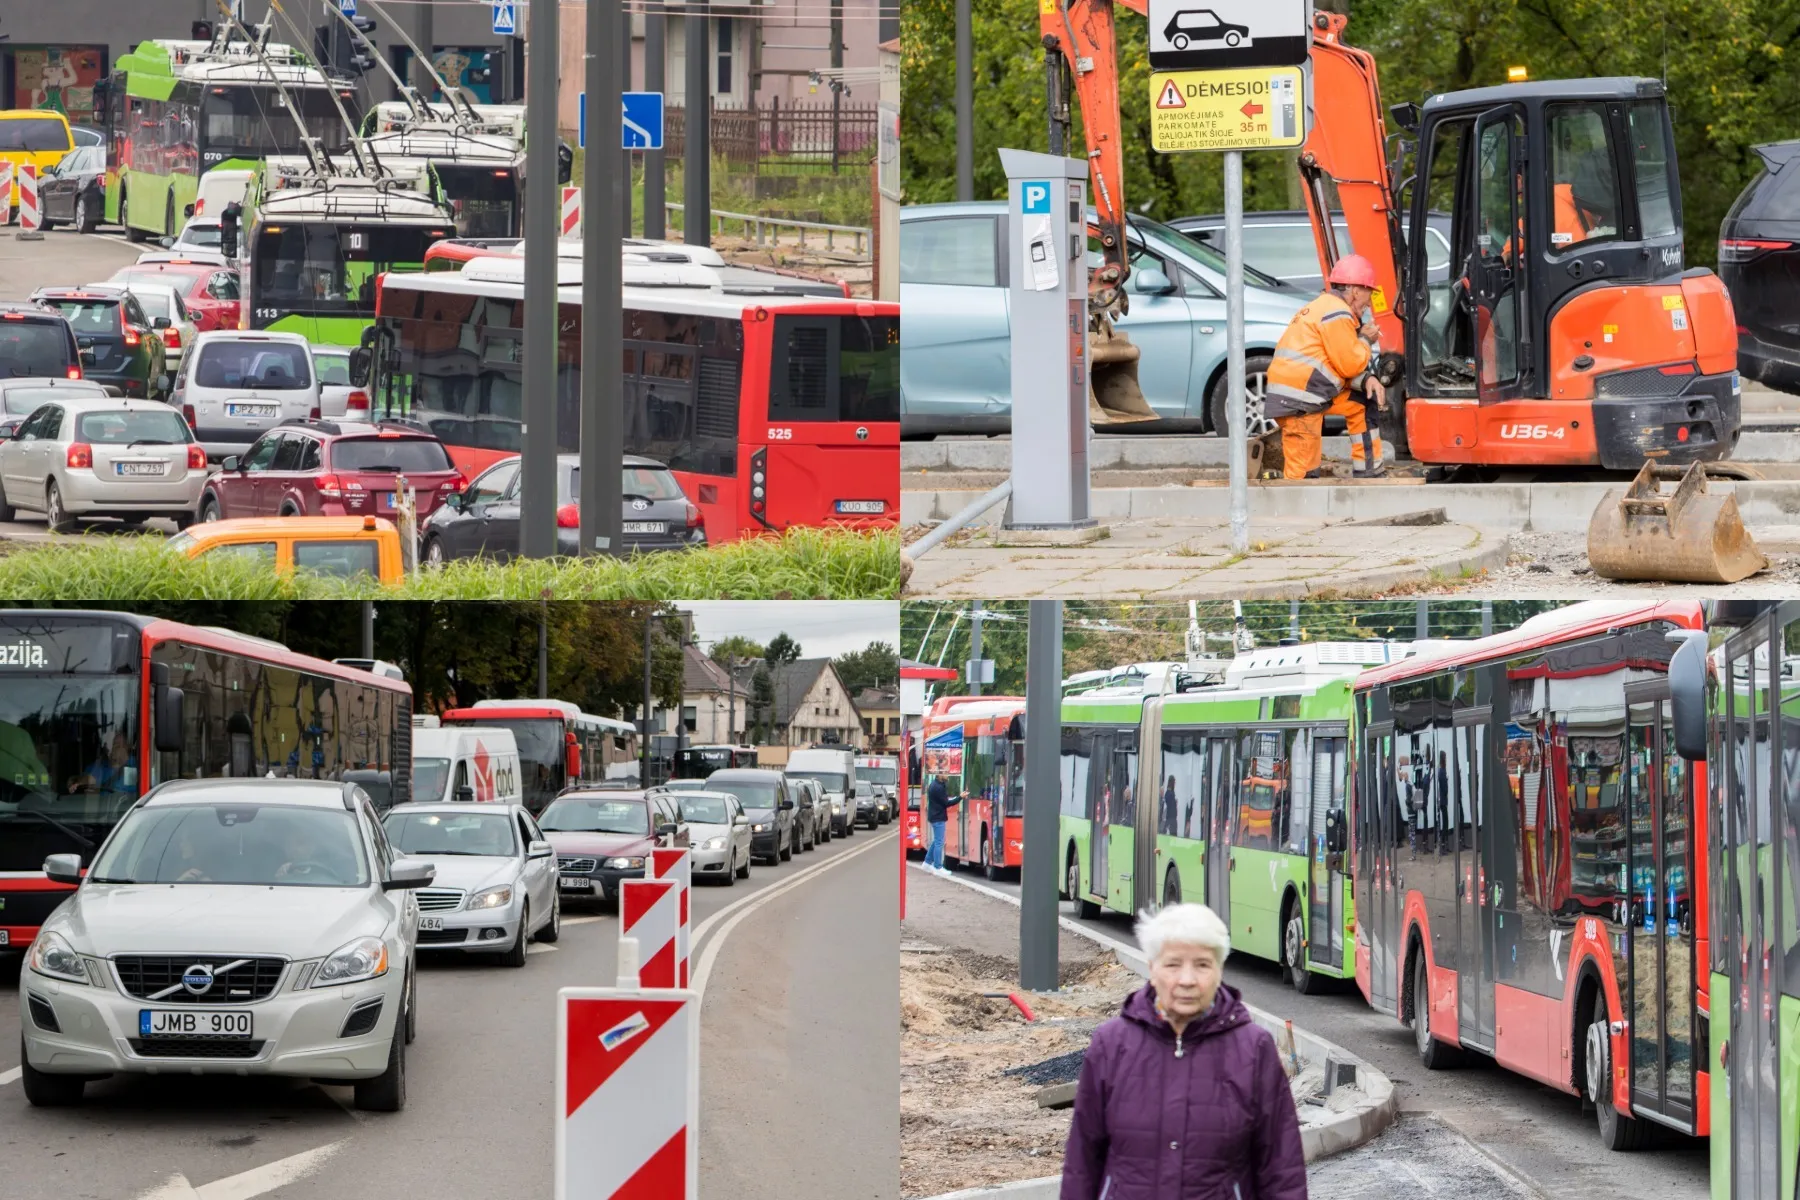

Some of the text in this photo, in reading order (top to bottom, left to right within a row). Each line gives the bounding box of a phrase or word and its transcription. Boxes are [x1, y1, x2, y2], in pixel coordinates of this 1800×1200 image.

[1186, 80, 1269, 98] DĖMESIO!
[1157, 110, 1224, 121] APMOKĖJIMAS
[1158, 120, 1217, 130] PARKOMATE
[1240, 121, 1267, 132] 35 m
[1158, 128, 1234, 140] GALIOJA TIK ŠIOJE
[1159, 140, 1185, 149] EILĖJE
[1199, 138, 1243, 148] STOVĖJIMO
[204, 152, 222, 160] 070
[1026, 186, 1046, 209] P
[349, 233, 362, 249] 10
[256, 308, 278, 319] 113
[236, 405, 275, 415] JPZ 727
[767, 428, 792, 440] 525
[1500, 424, 1565, 440] U36-4
[123, 464, 141, 473] CNT
[842, 502, 883, 512] KUO 905
[646, 523, 663, 532] 671
[496, 756, 514, 803] dpd
[572, 878, 588, 887] 998
[420, 919, 441, 929] 484
[153, 1013, 248, 1032] JMB 900
